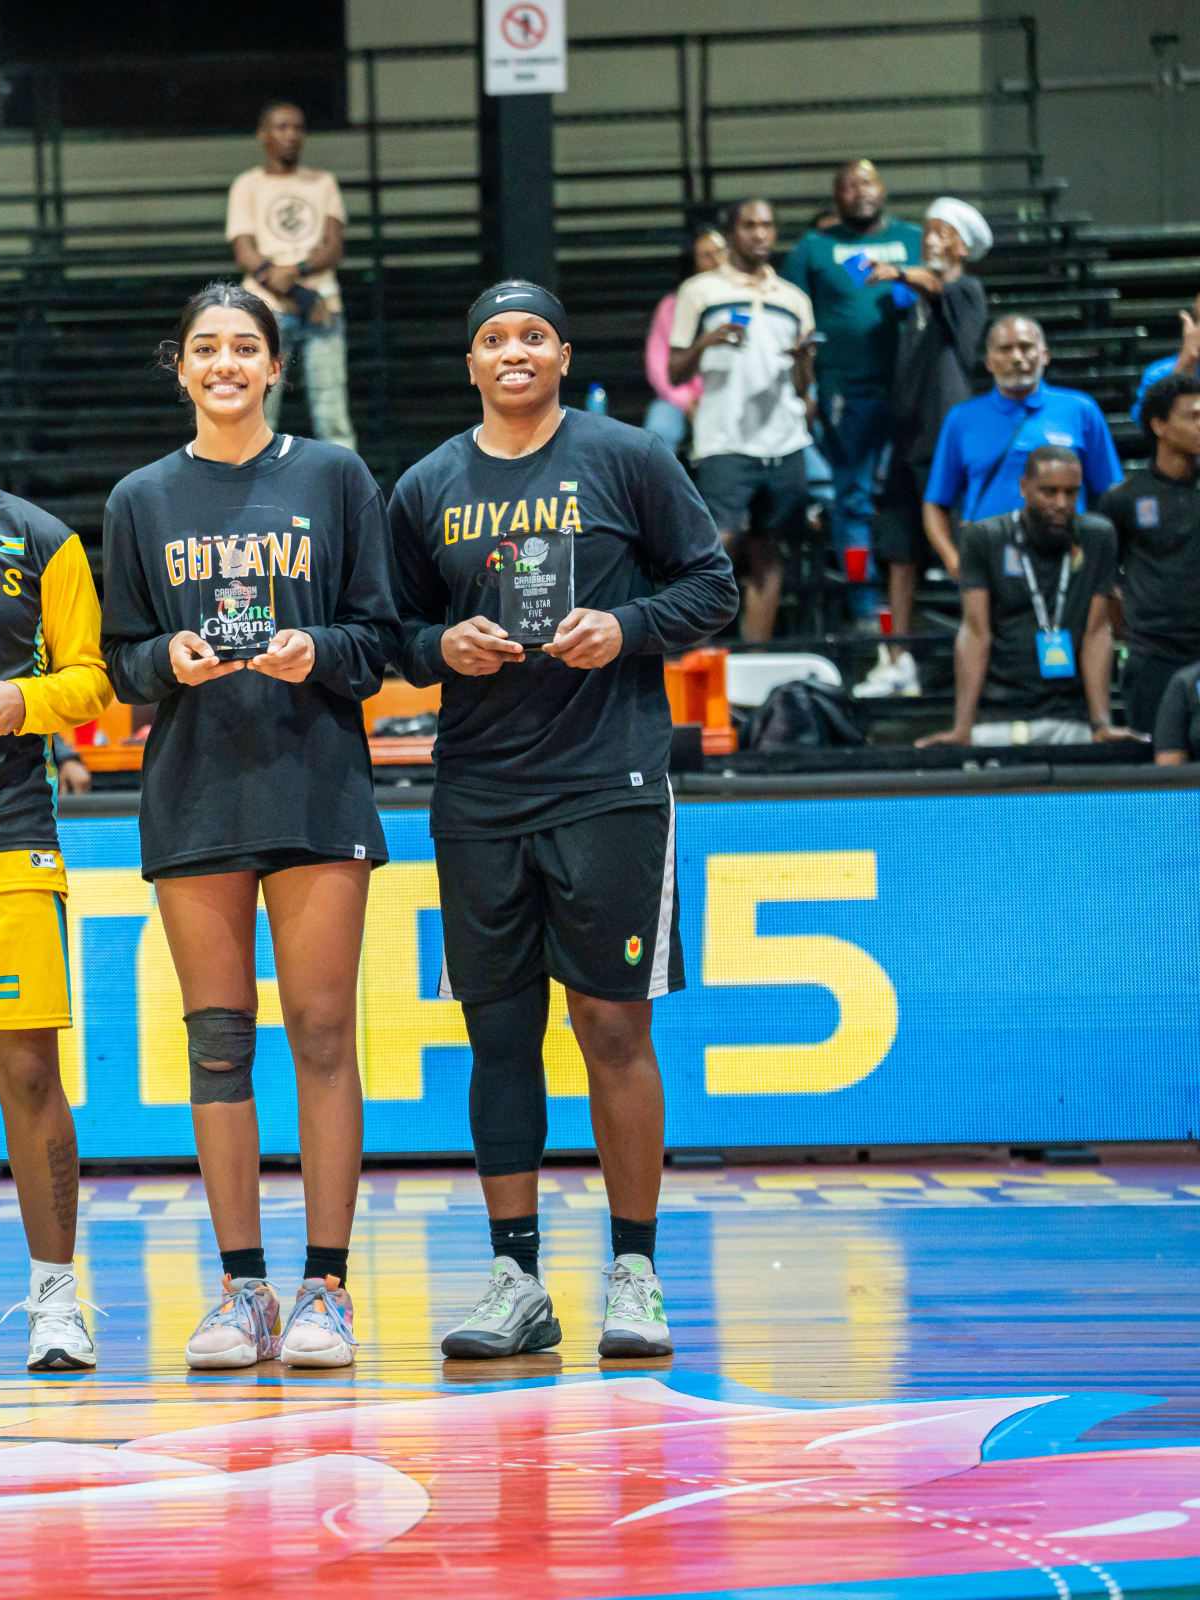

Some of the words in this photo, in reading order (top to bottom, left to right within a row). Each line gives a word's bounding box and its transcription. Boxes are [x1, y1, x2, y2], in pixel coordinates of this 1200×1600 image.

[444, 496, 583, 545] GUYANA
[165, 532, 310, 586] GUYANA
[514, 574, 556, 585] CARIBBEAN
[521, 601, 533, 610] ALL
[535, 599, 551, 608] STAR
[528, 609, 542, 618] FIVE
[203, 617, 271, 639] Guyana
[704, 850, 899, 1096] 5
